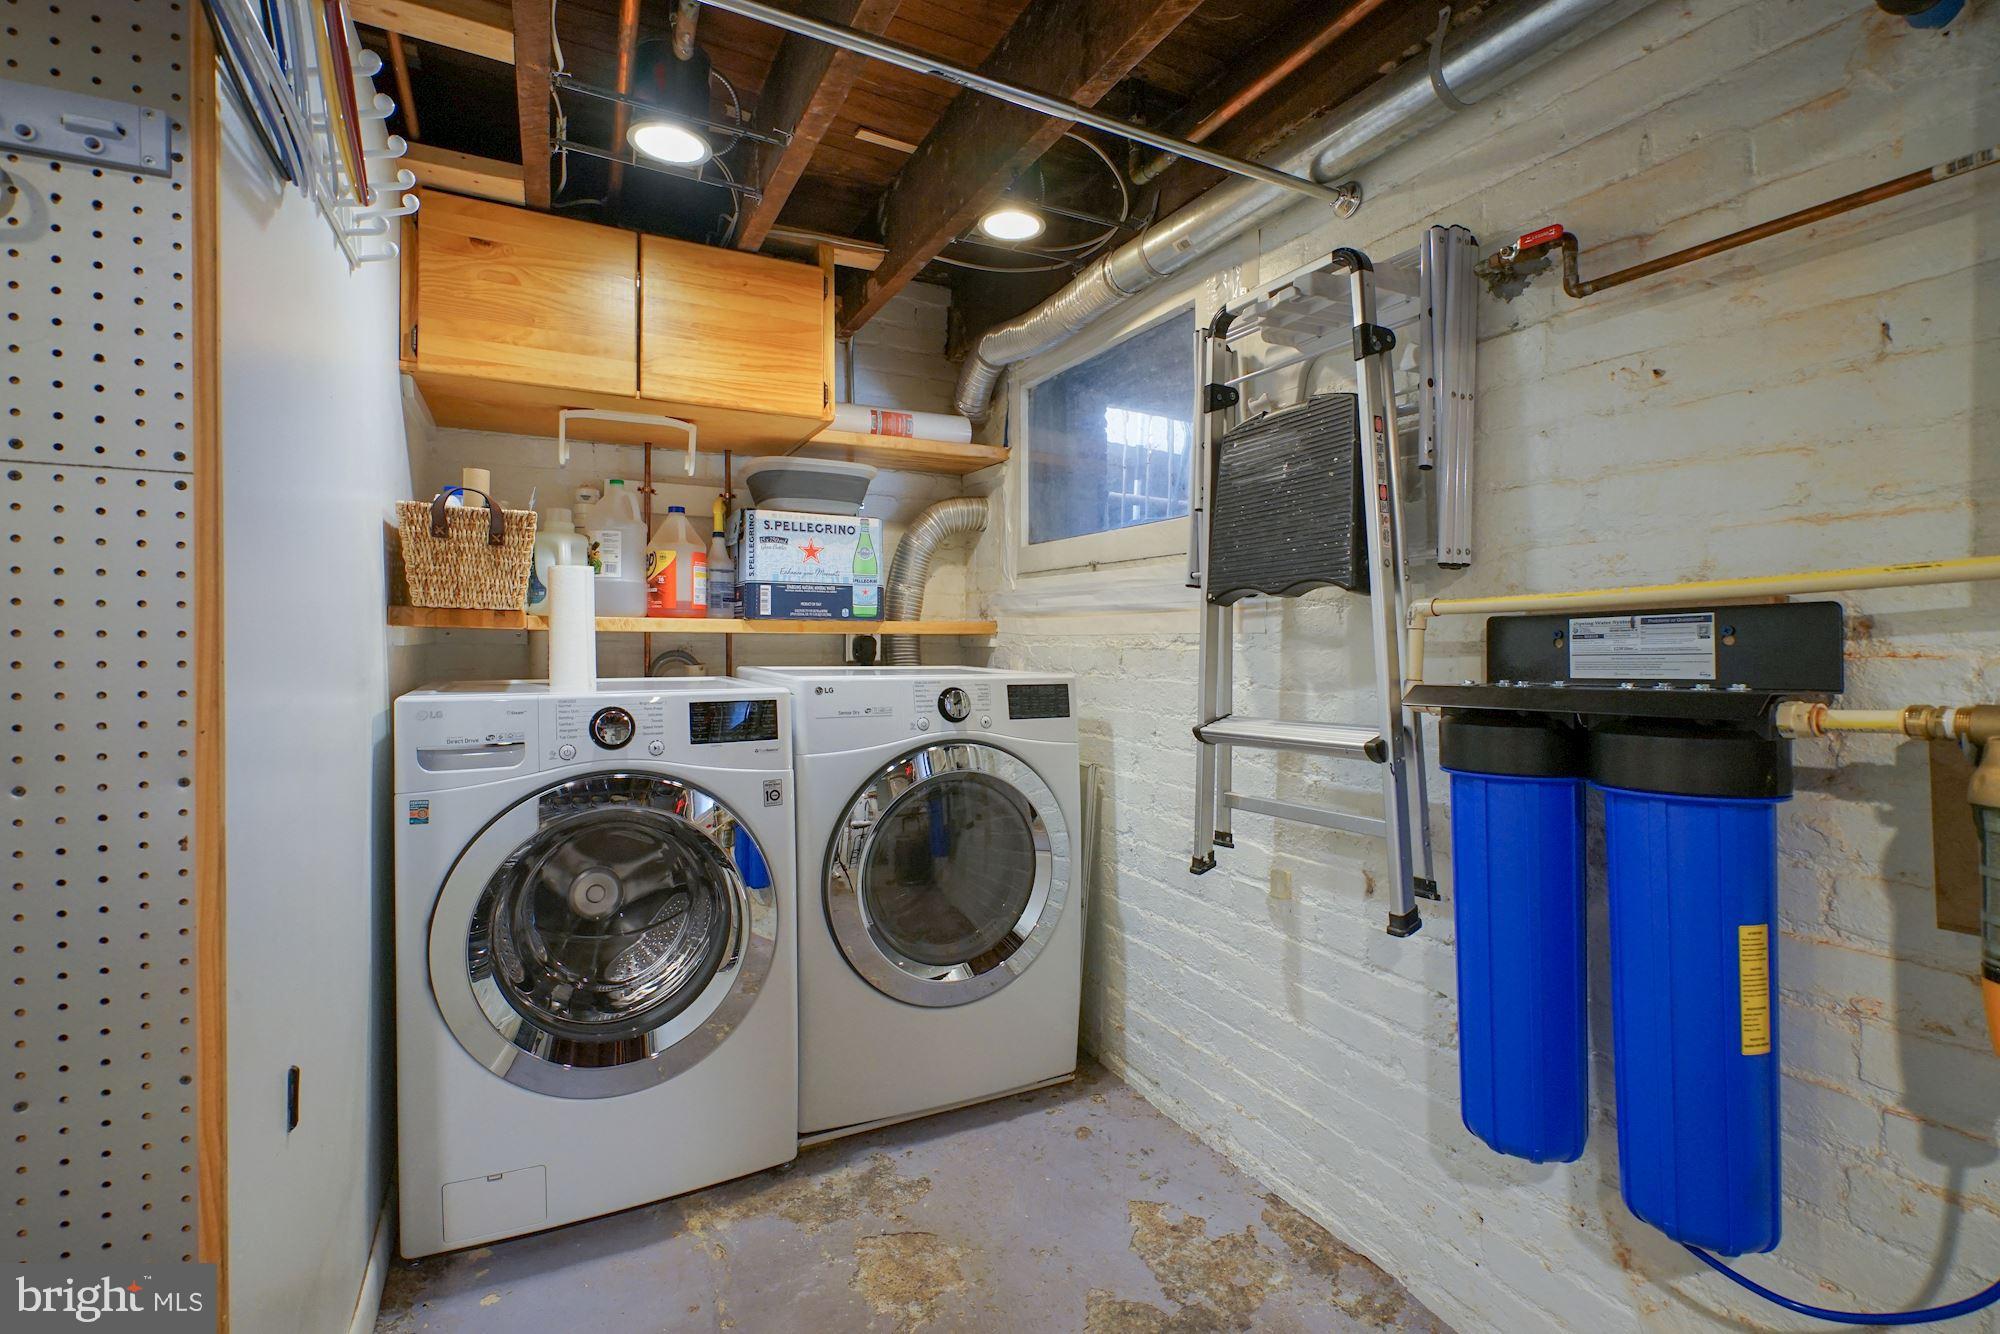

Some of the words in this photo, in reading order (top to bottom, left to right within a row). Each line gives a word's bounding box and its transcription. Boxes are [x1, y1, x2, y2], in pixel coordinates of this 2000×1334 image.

[763, 520, 856, 536] S.PELLEGRINO
[429, 710, 443, 719] LG
[766, 789, 781, 802] 10
